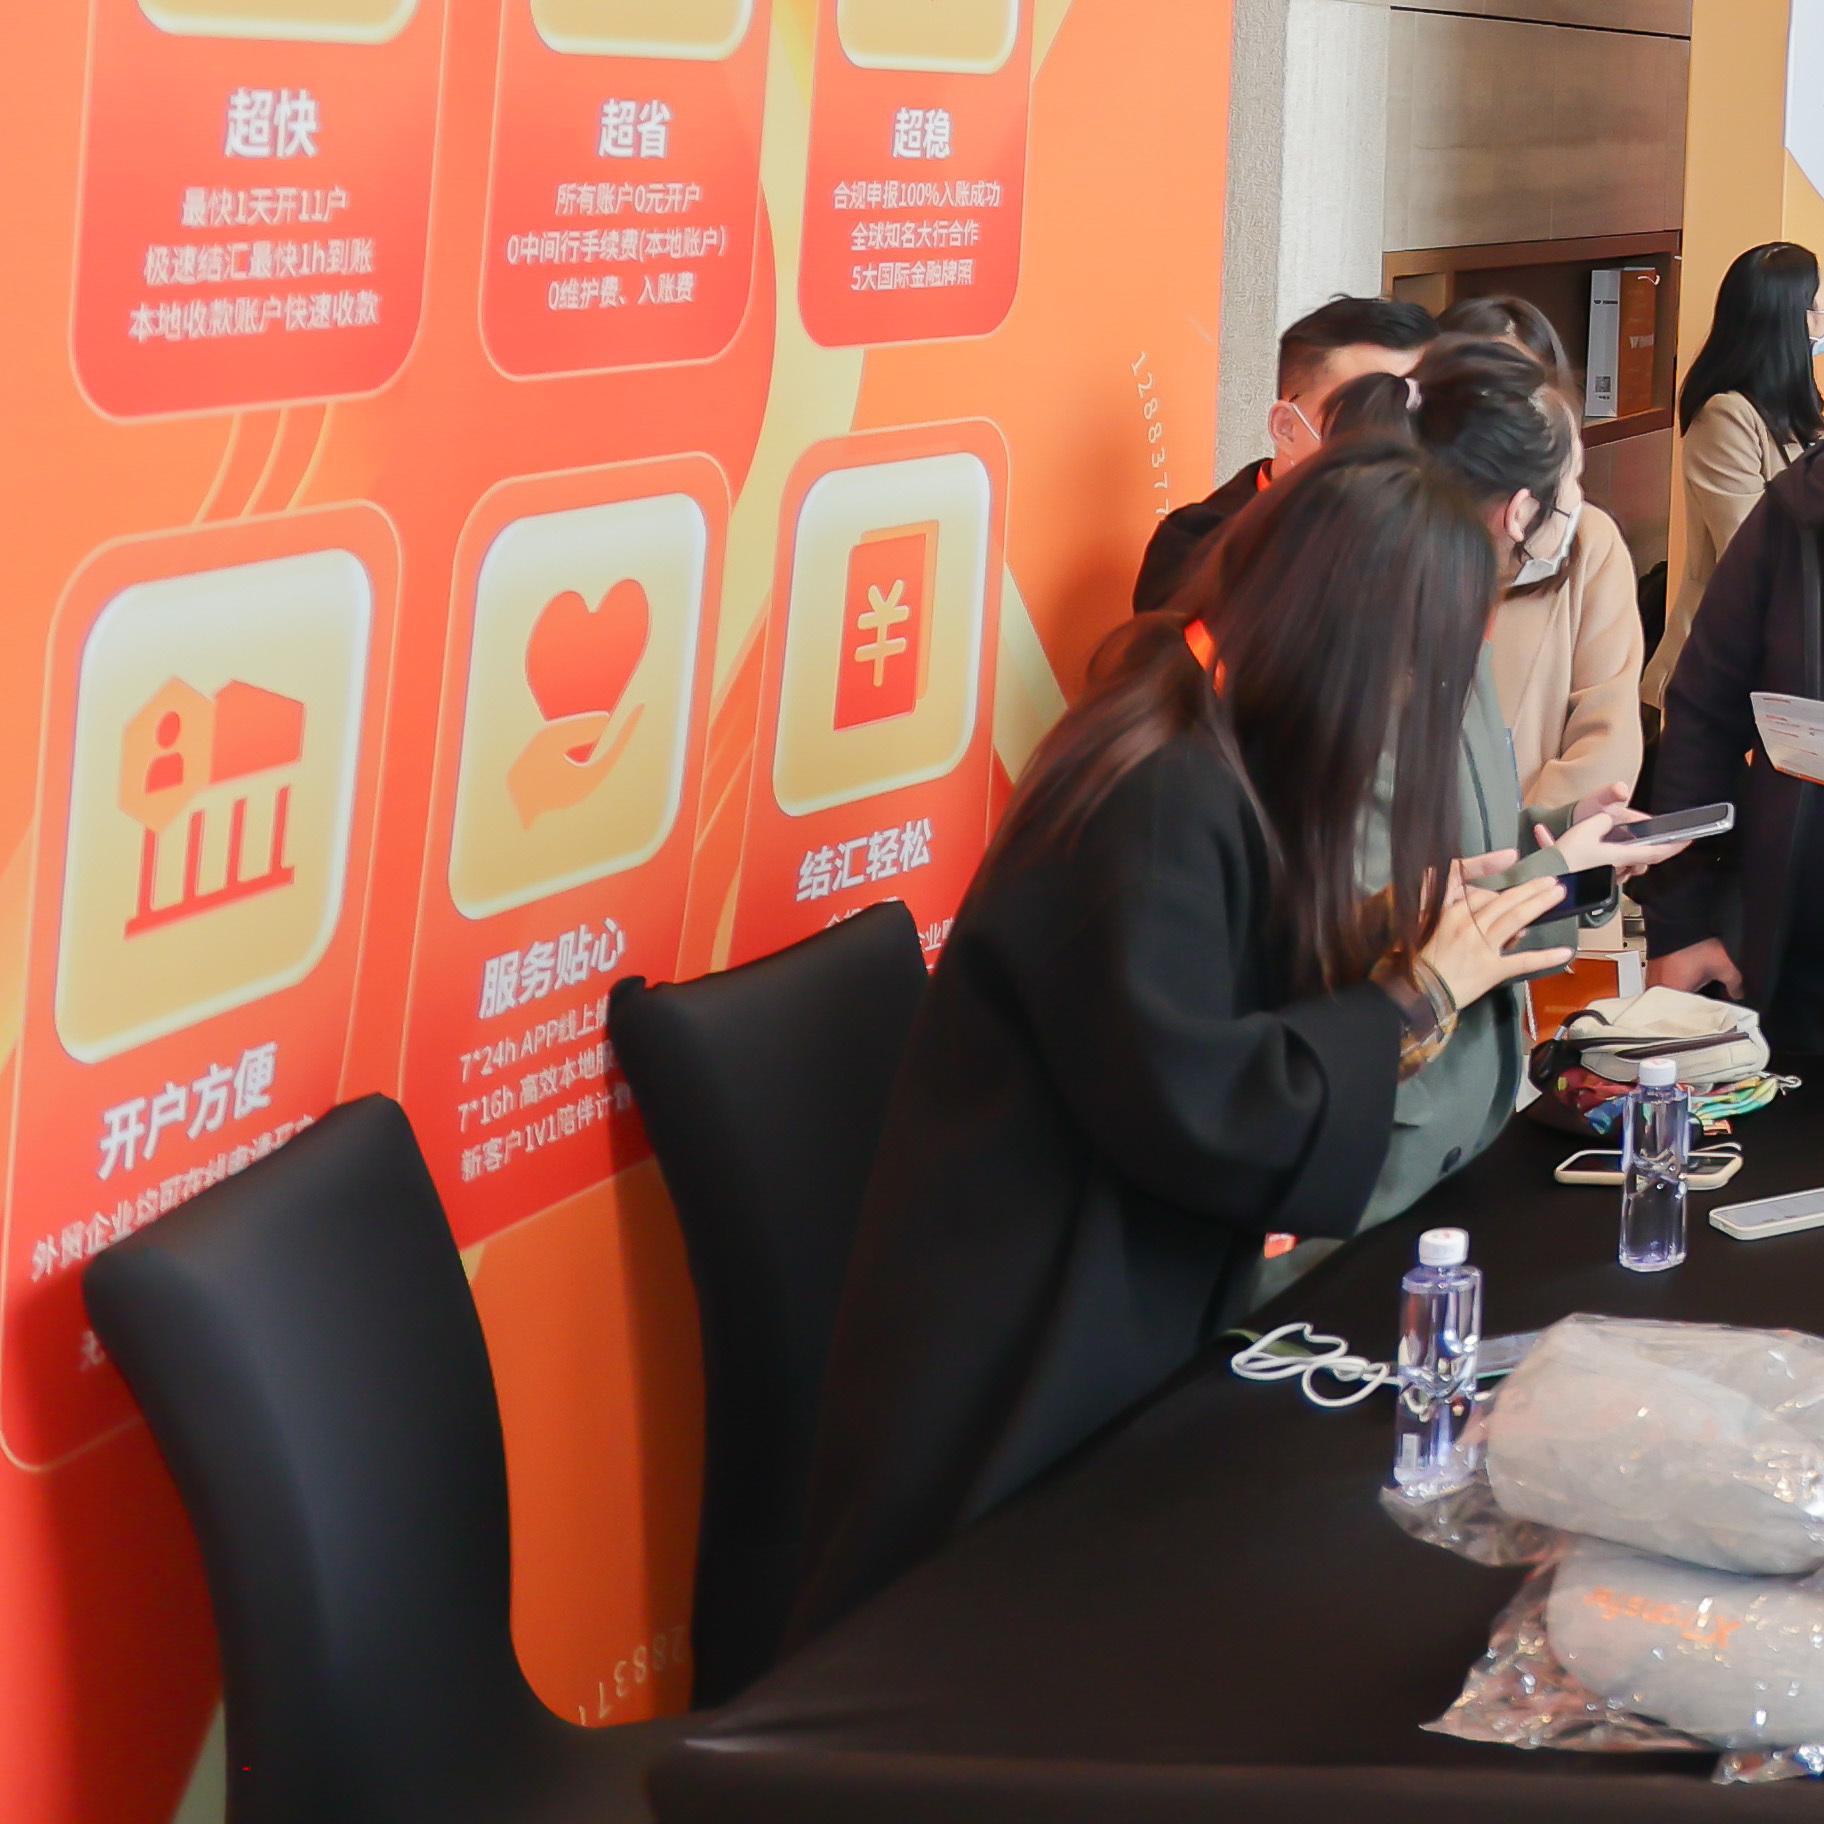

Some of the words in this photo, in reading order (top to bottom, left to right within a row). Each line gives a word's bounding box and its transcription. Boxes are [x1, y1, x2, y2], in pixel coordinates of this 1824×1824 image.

[224, 87, 319, 157] 超快
[598, 97, 673, 158] 超省
[892, 106, 951, 159] 超稳
[181, 186, 349, 227] 最快1天开11户
[555, 181, 703, 216] 所有账户0元开户
[833, 179, 1002, 210] 合规申报100%入账成功
[506, 225, 728, 265] 0中间行手续费(本地账户)
[851, 218, 981, 251] 全球知名大行合作
[143, 238, 375, 286] 极速结汇最快1h到账
[850, 258, 974, 291] 5大国际金融牌照
[547, 271, 695, 311] 0维护费、入账费
[128, 289, 380, 343] 本地收款账户快速收款
[796, 816, 935, 902] 结汇轻松
[478, 917, 626, 1020] 服务贴心
[97, 1040, 279, 1181] 开户方便
